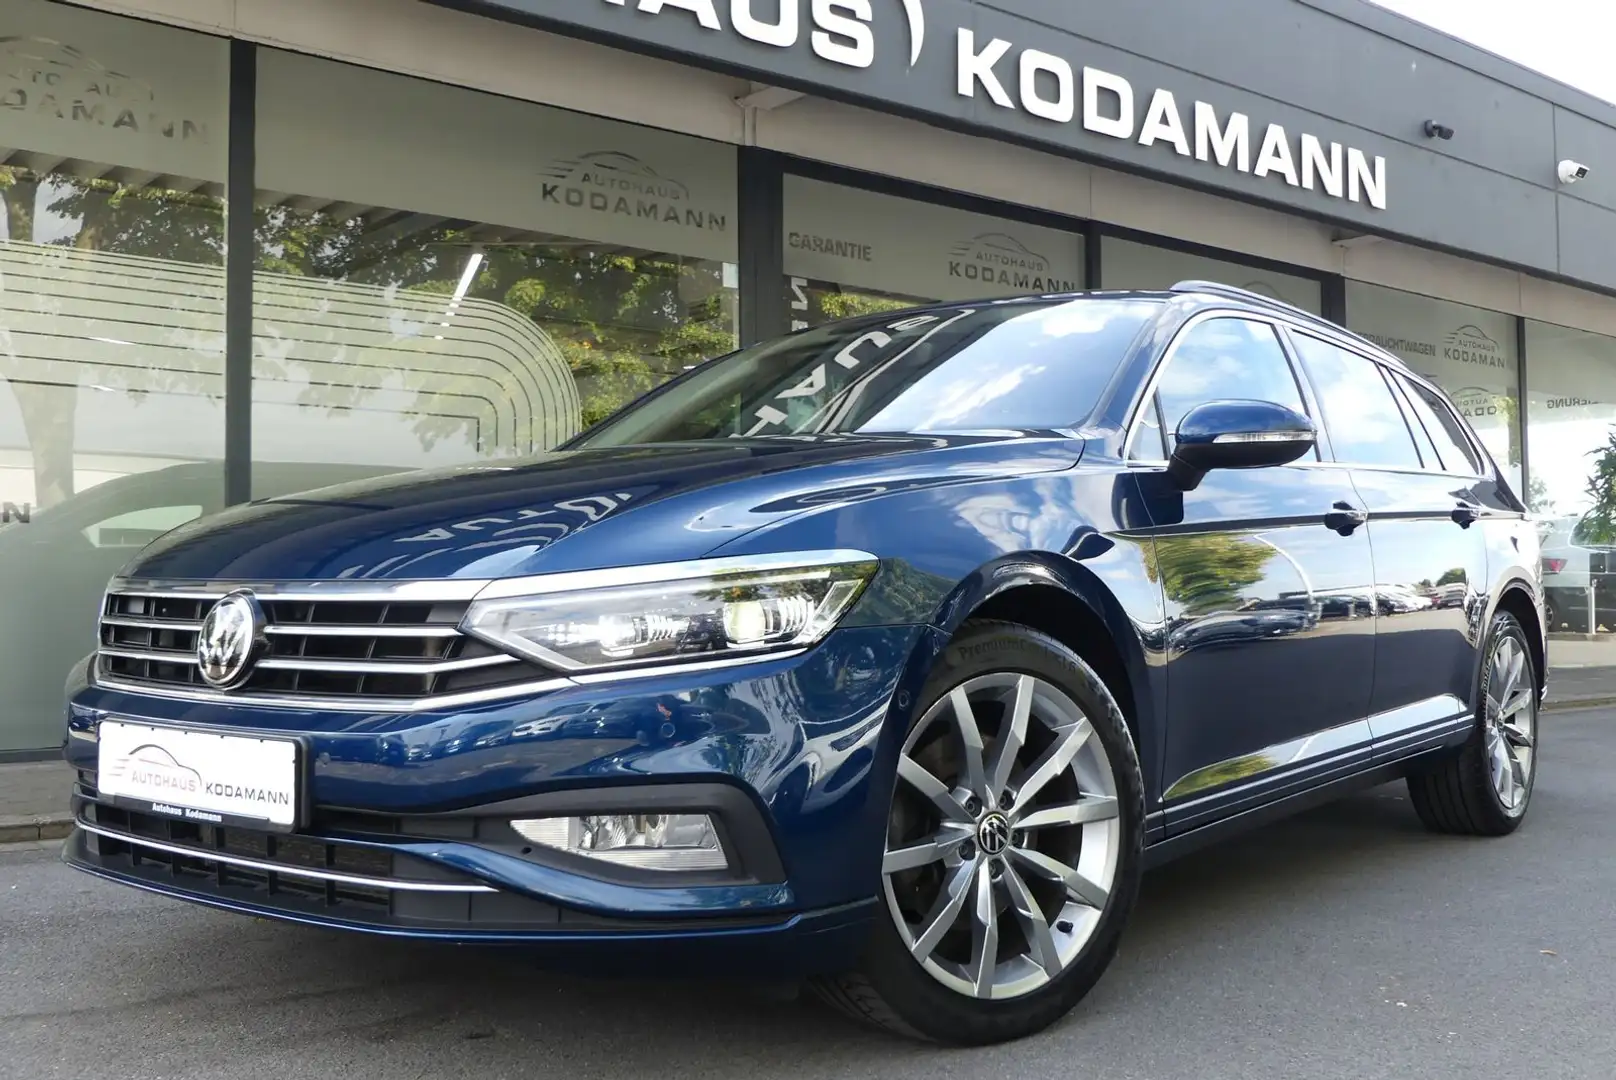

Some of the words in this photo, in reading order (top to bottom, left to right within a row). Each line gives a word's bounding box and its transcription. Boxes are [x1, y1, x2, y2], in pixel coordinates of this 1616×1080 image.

[603, 0, 875, 68] US
[956, 27, 1388, 211] KODAMANN
[581, 172, 681, 200] AUTOHAUS
[541, 182, 727, 232] KODAMANN
[788, 231, 872, 262] GARANTIE
[975, 251, 1044, 272] AUTOHAUS
[948, 260, 1077, 293] KODAMANN
[1352, 331, 1436, 356] BRAUCHTWAGEN
[131, 770, 196, 793] AUTOHAUS
[205, 782, 289, 806] KODAMANN
[152, 802, 182, 816] Autohaus
[185, 809, 222, 823] Kodamann
